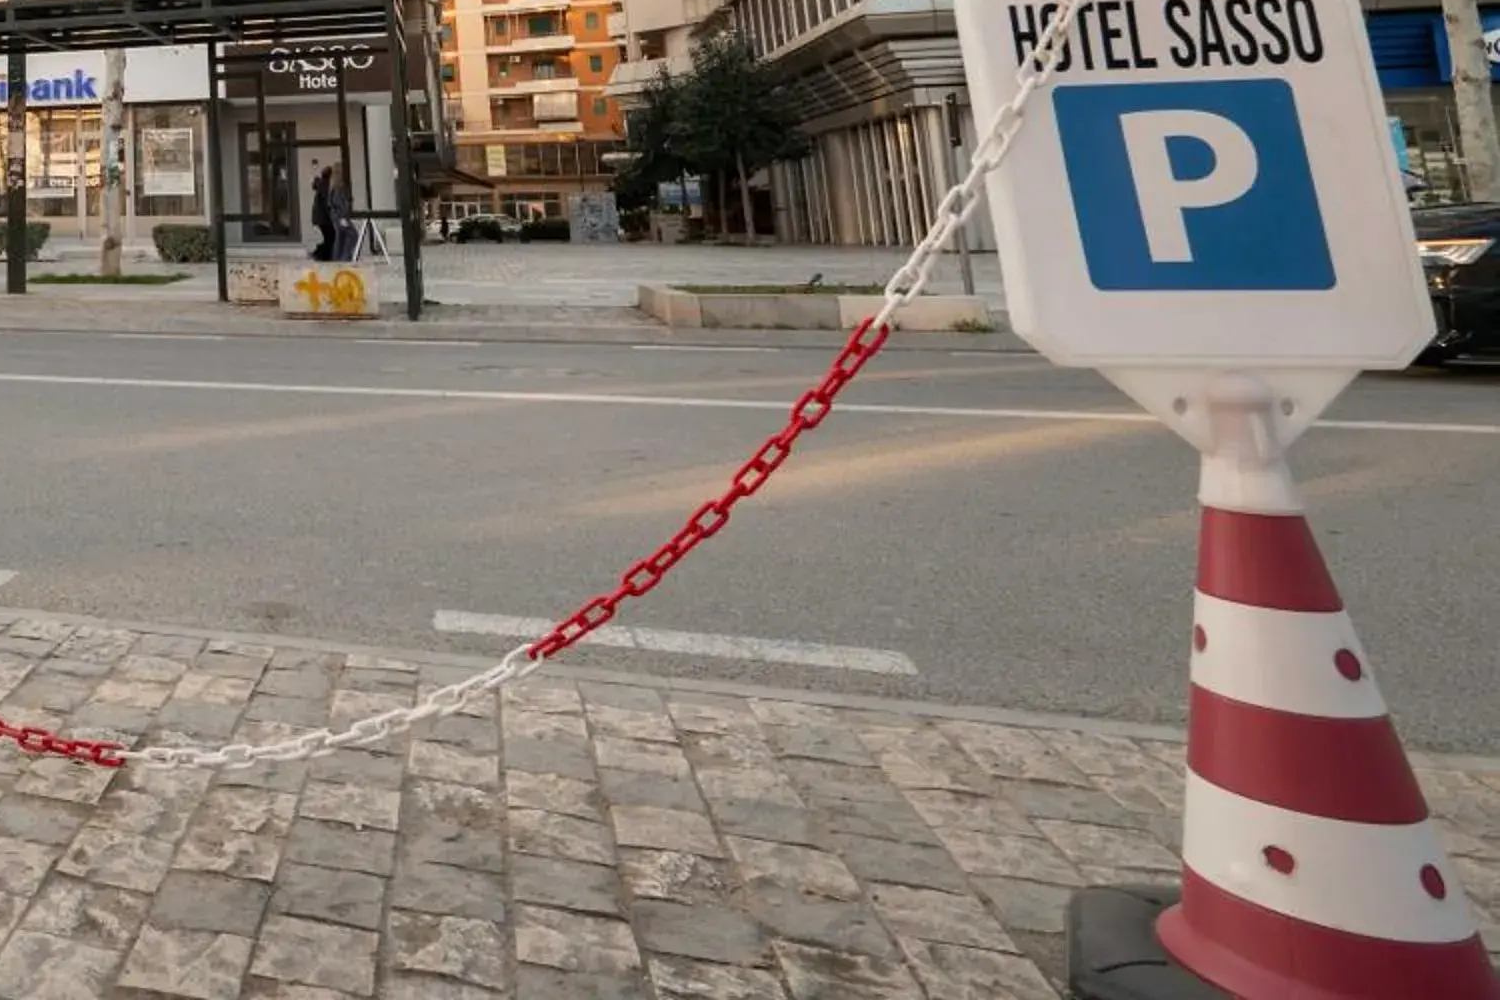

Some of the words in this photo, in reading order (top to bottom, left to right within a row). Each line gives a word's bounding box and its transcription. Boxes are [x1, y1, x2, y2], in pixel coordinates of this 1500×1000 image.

[1007, 0, 1158, 73] HOTEL
[299, 73, 338, 89] Hote
[1119, 109, 1259, 263] P
